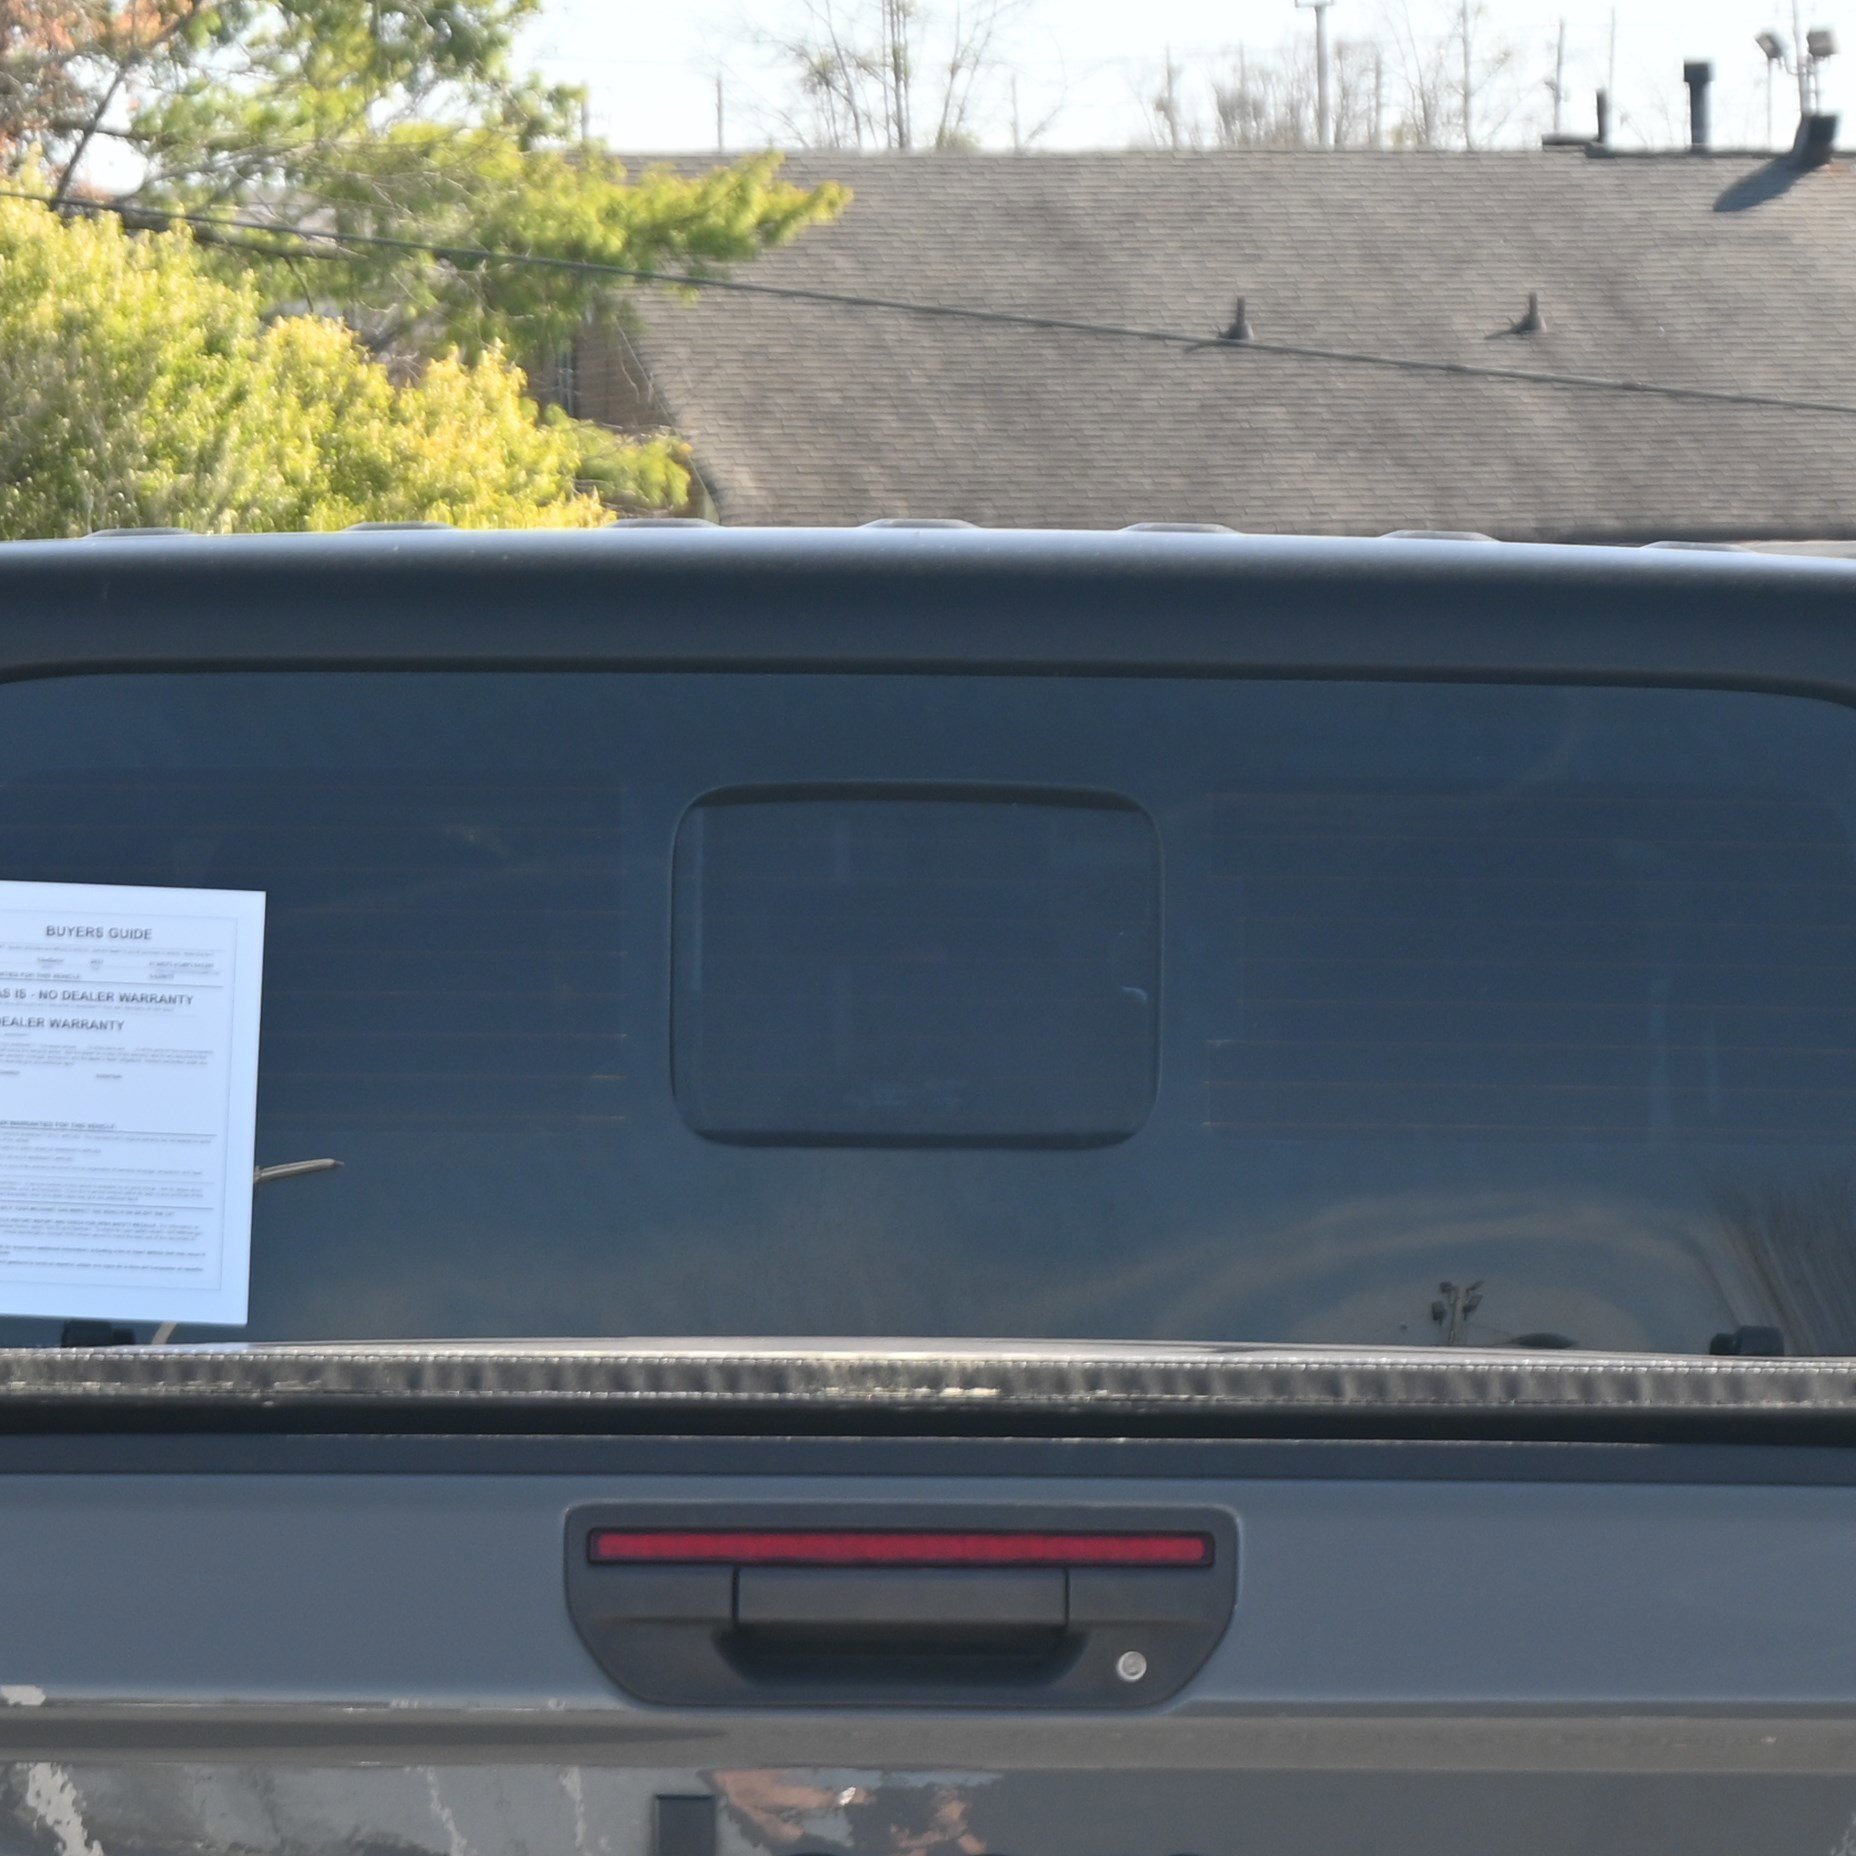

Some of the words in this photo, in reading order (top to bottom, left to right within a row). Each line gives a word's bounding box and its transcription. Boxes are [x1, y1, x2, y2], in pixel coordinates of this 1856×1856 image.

[45, 925, 104, 939] BUYERS
[108, 927, 153, 941] GUIDE
[14, 988, 27, 1000] IS
[38, 989, 58, 1001] NO
[62, 990, 115, 1003] DEALER
[118, 992, 194, 1006] WARRANTY
[48, 1017, 125, 1032] WARRANTY
